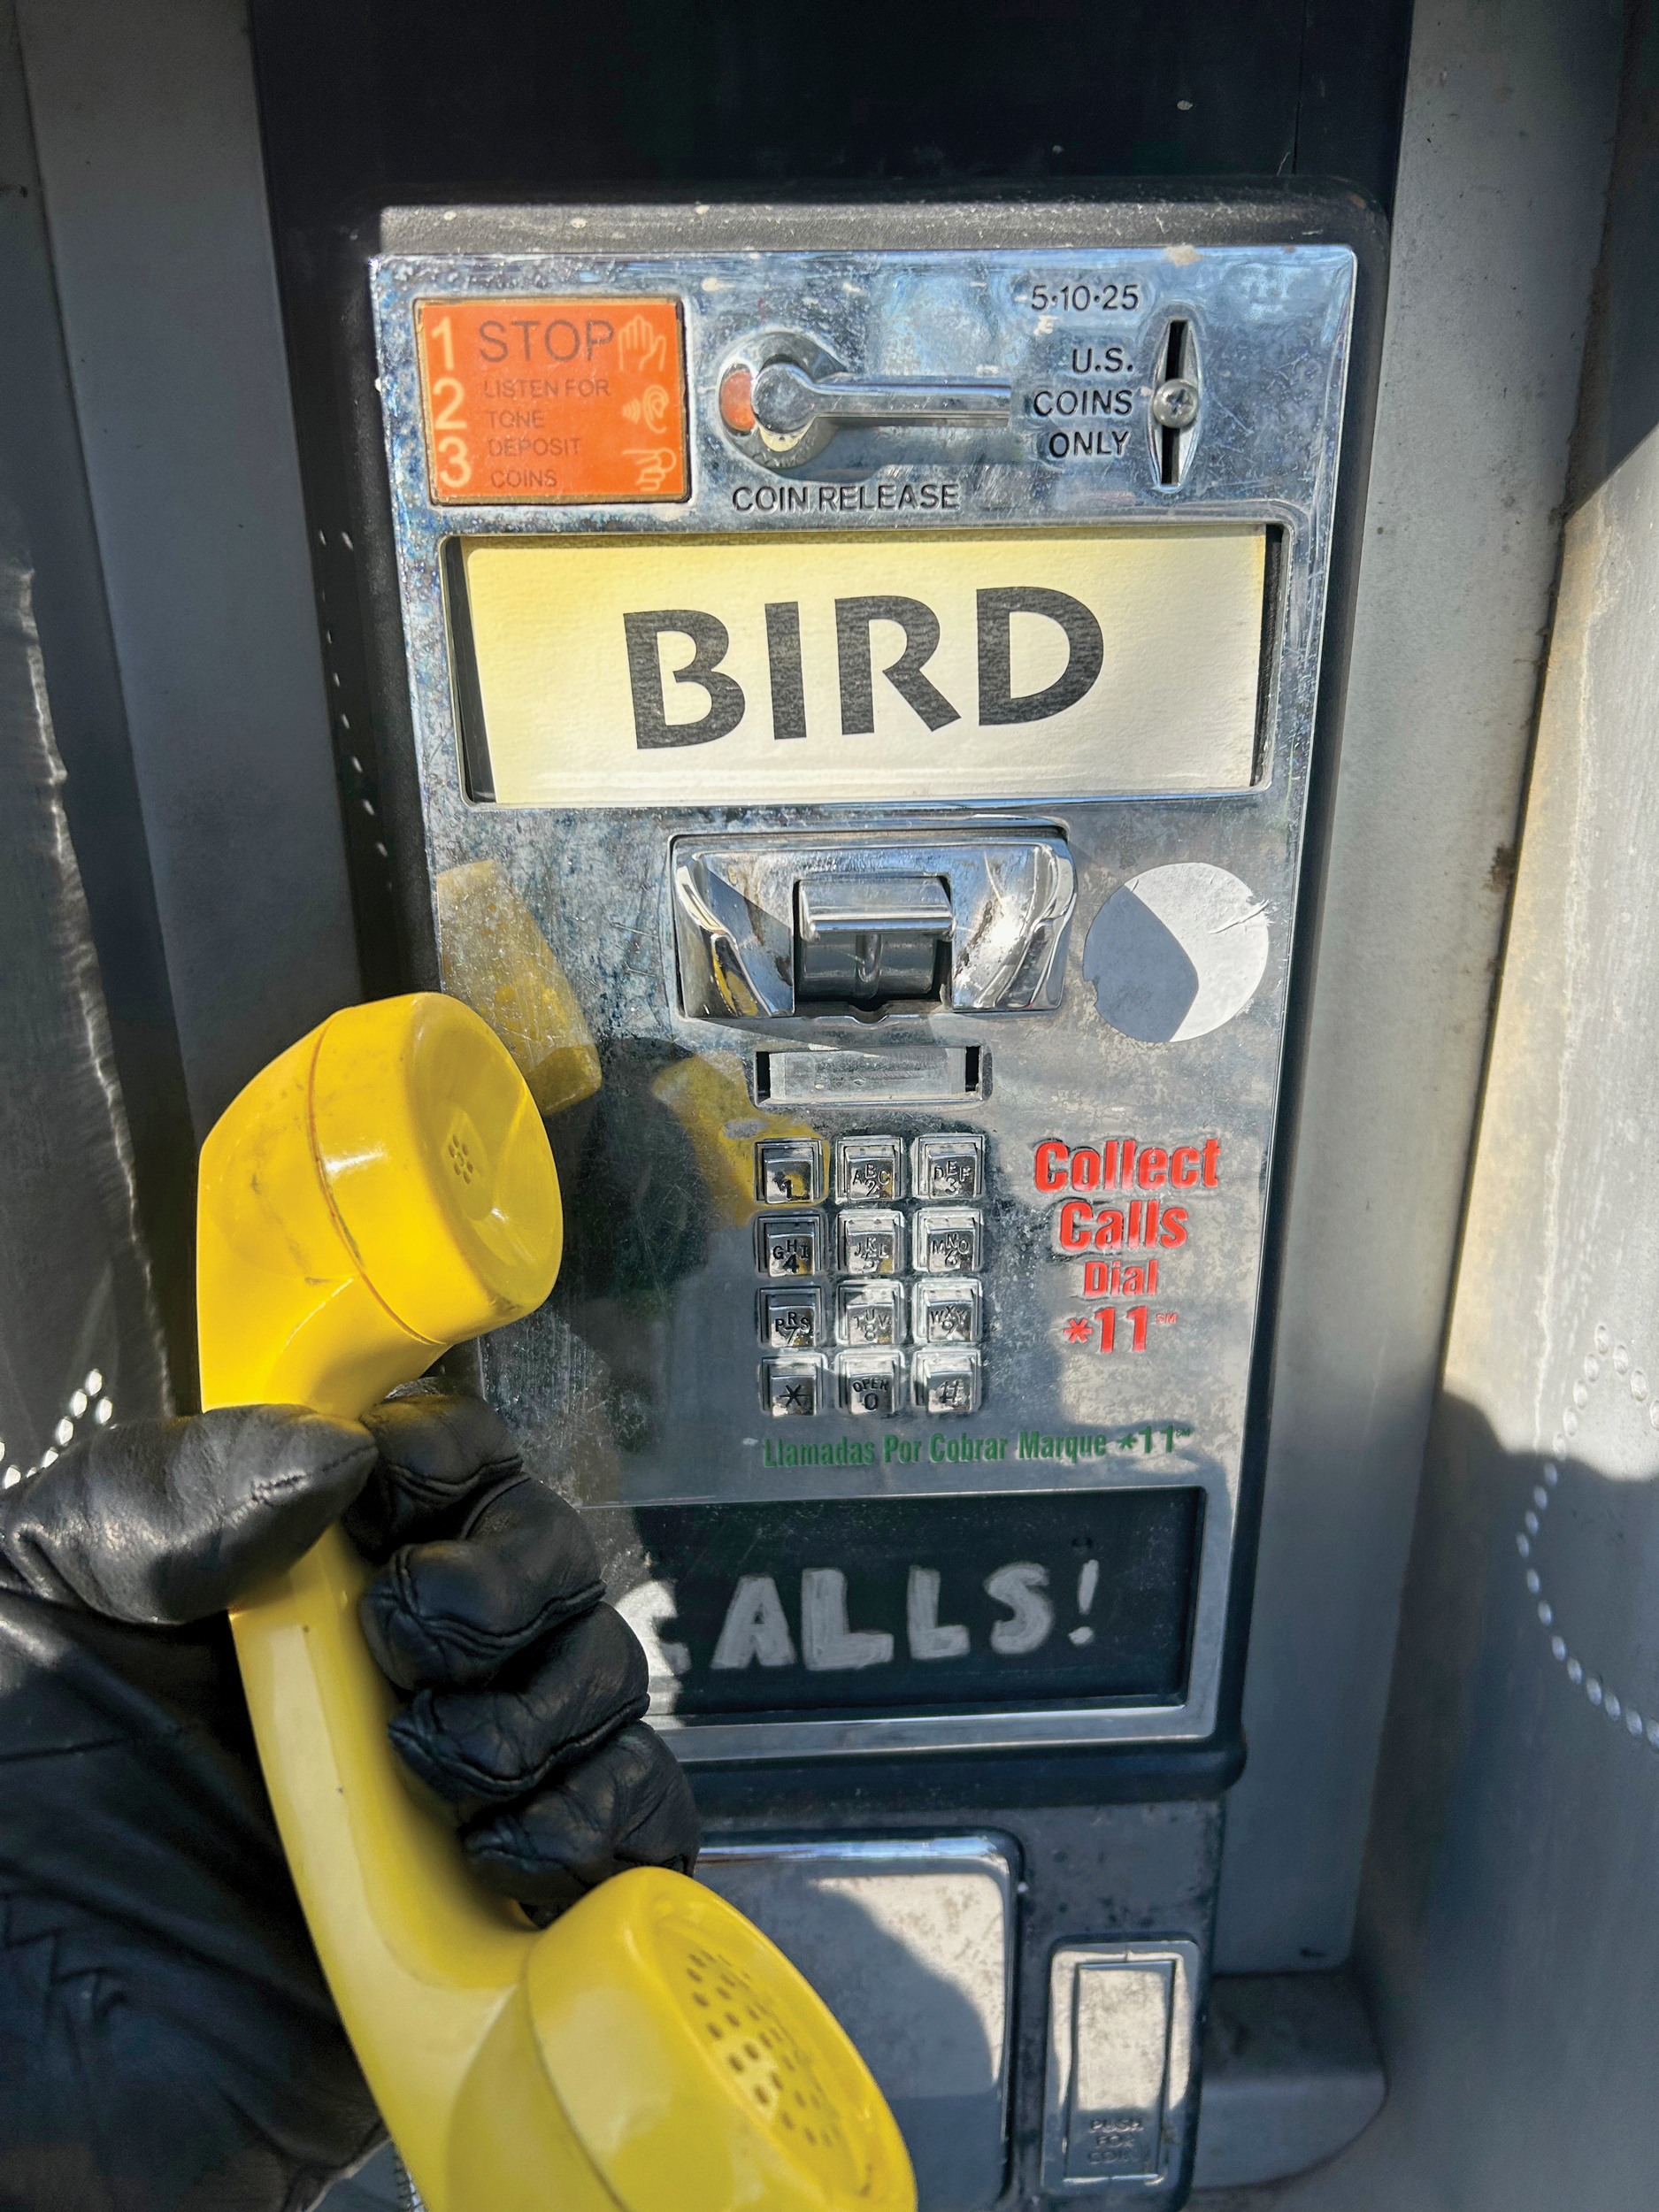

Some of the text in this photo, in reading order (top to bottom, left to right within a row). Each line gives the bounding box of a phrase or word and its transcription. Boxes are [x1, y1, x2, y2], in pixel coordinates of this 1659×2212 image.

[431, 318, 614, 371] 1 STOP
[1071, 348, 1133, 373] U.S.
[433, 378, 610, 431] 2 LISTEN FOR
[1033, 389, 1133, 417] COINS
[487, 411, 545, 430] TONE
[1049, 431, 1130, 458] ONLY
[436, 436, 580, 489] 3 DEPOSIT
[491, 469, 557, 489] COINS
[733, 484, 960, 513] COIN RELEASE
[622, 586, 1104, 750] BIRD
[1034, 1139, 1220, 1193] Collect
[865, 1179, 880, 1197] 2
[1060, 1200, 1188, 1251] Calls
[1084, 1260, 1158, 1297] Dial
[852, 1378, 888, 1393] OPER
[763, 1436, 874, 1467] Llamadas
[885, 1434, 921, 1464] Por
[930, 1432, 1009, 1463] Cobrar
[1018, 1431, 1107, 1465] Marque
